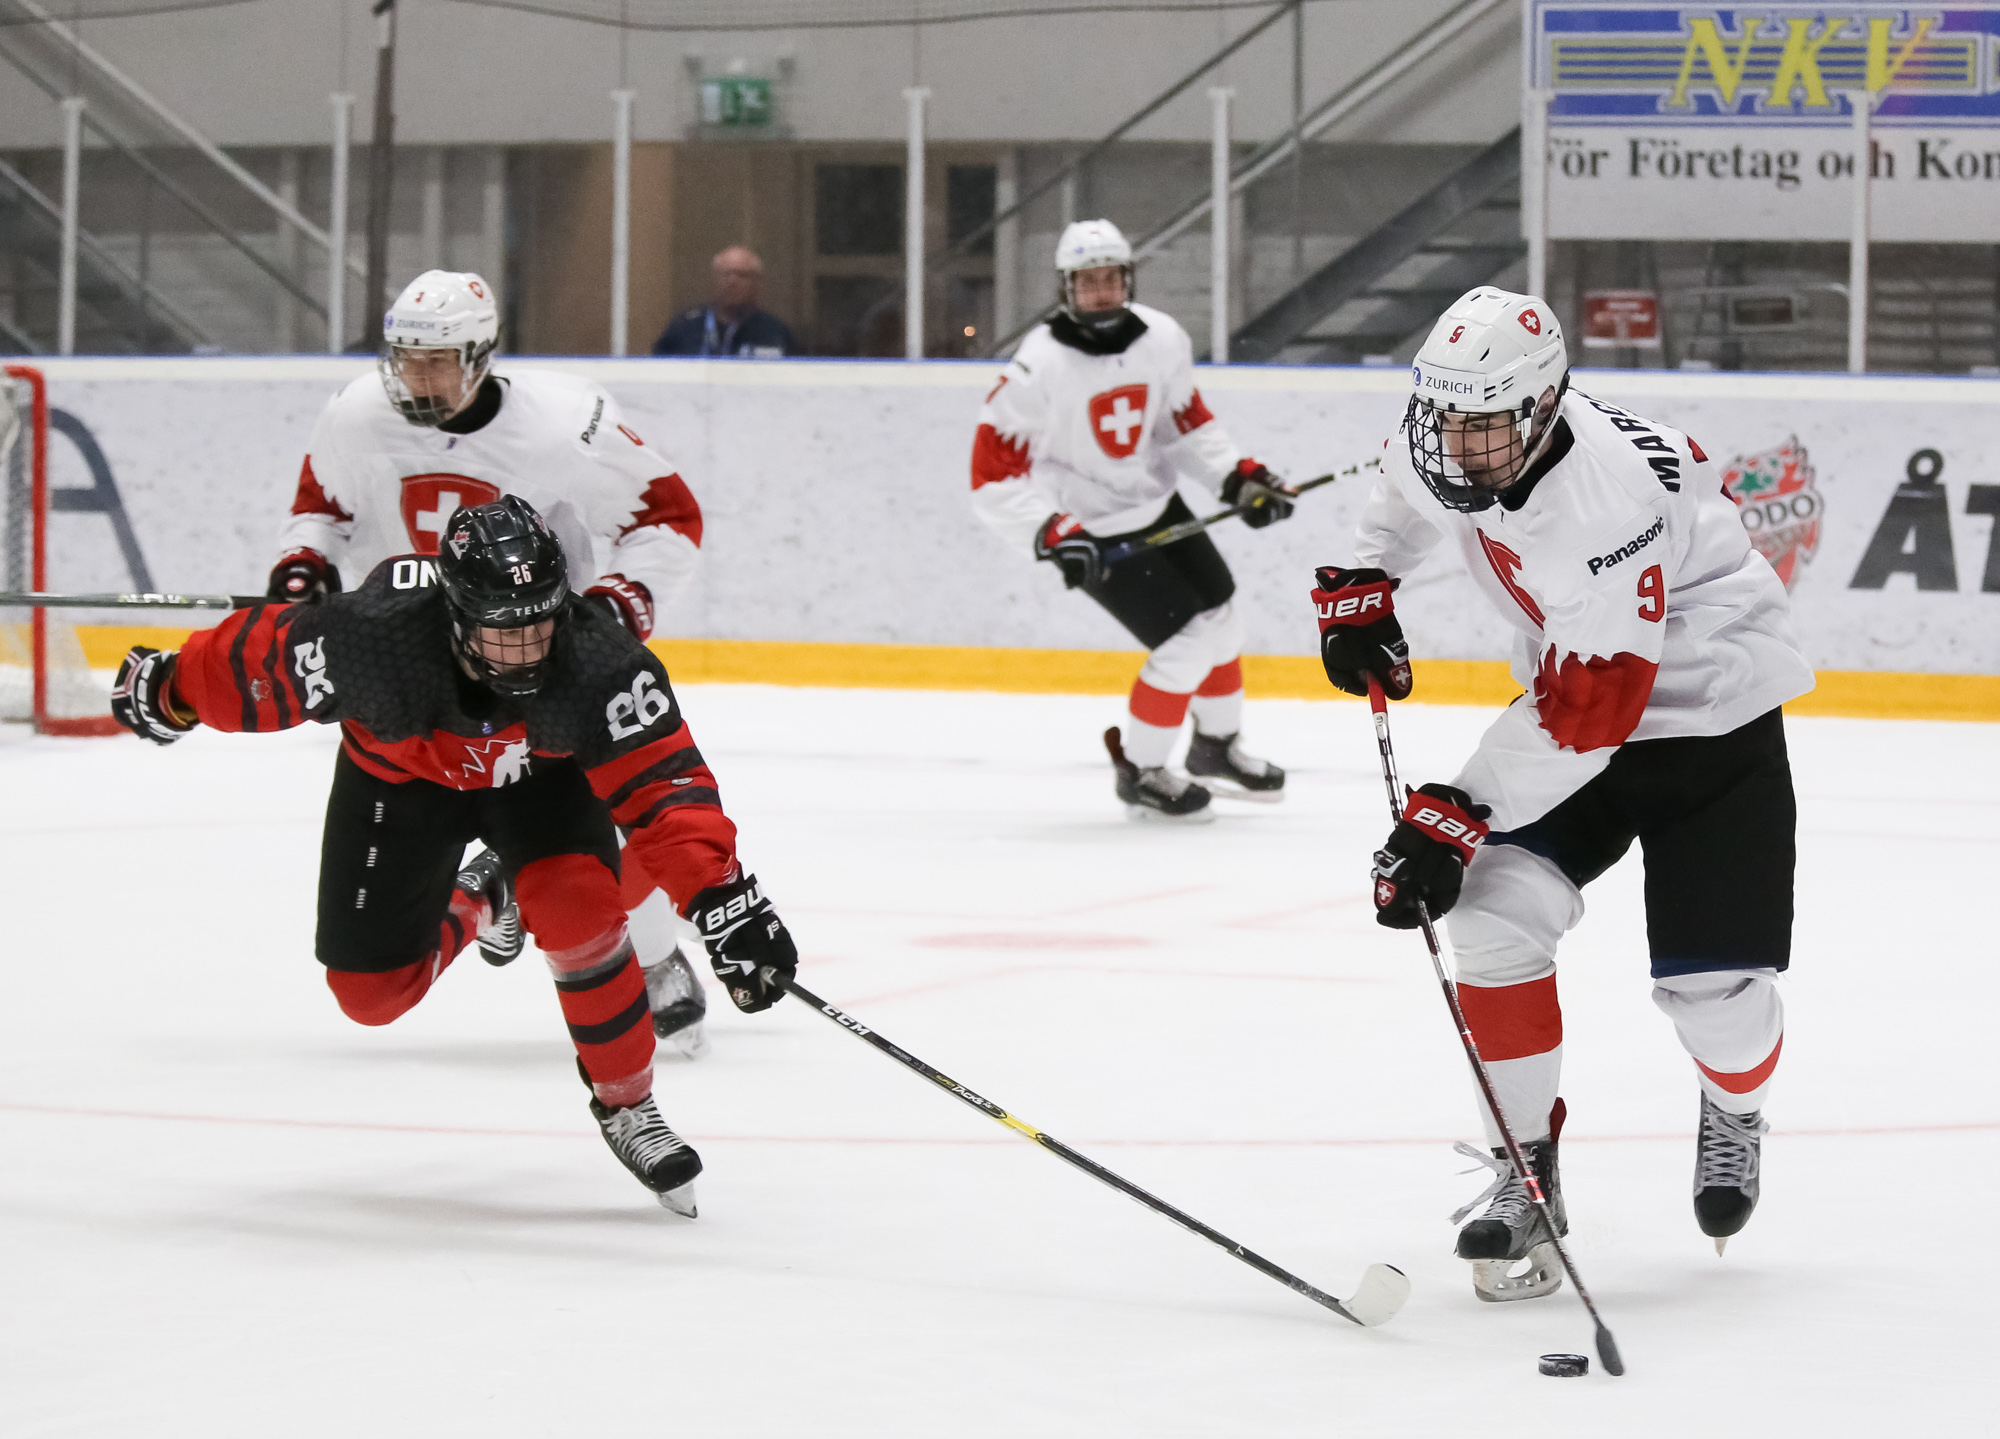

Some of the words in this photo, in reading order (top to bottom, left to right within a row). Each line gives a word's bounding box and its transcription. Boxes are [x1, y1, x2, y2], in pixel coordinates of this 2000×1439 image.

[1666, 17, 1935, 107] NKV
[1546, 137, 1609, 179] ör
[1628, 138, 1802, 190] Företag
[1449, 325, 1465, 343] 9
[1425, 376, 1473, 395] ZURICH
[511, 563, 532, 585] 26
[514, 597, 557, 617] TELUS
[1637, 563, 1665, 623] 9
[606, 670, 670, 742] 26
[821, 1003, 871, 1036] CCM
